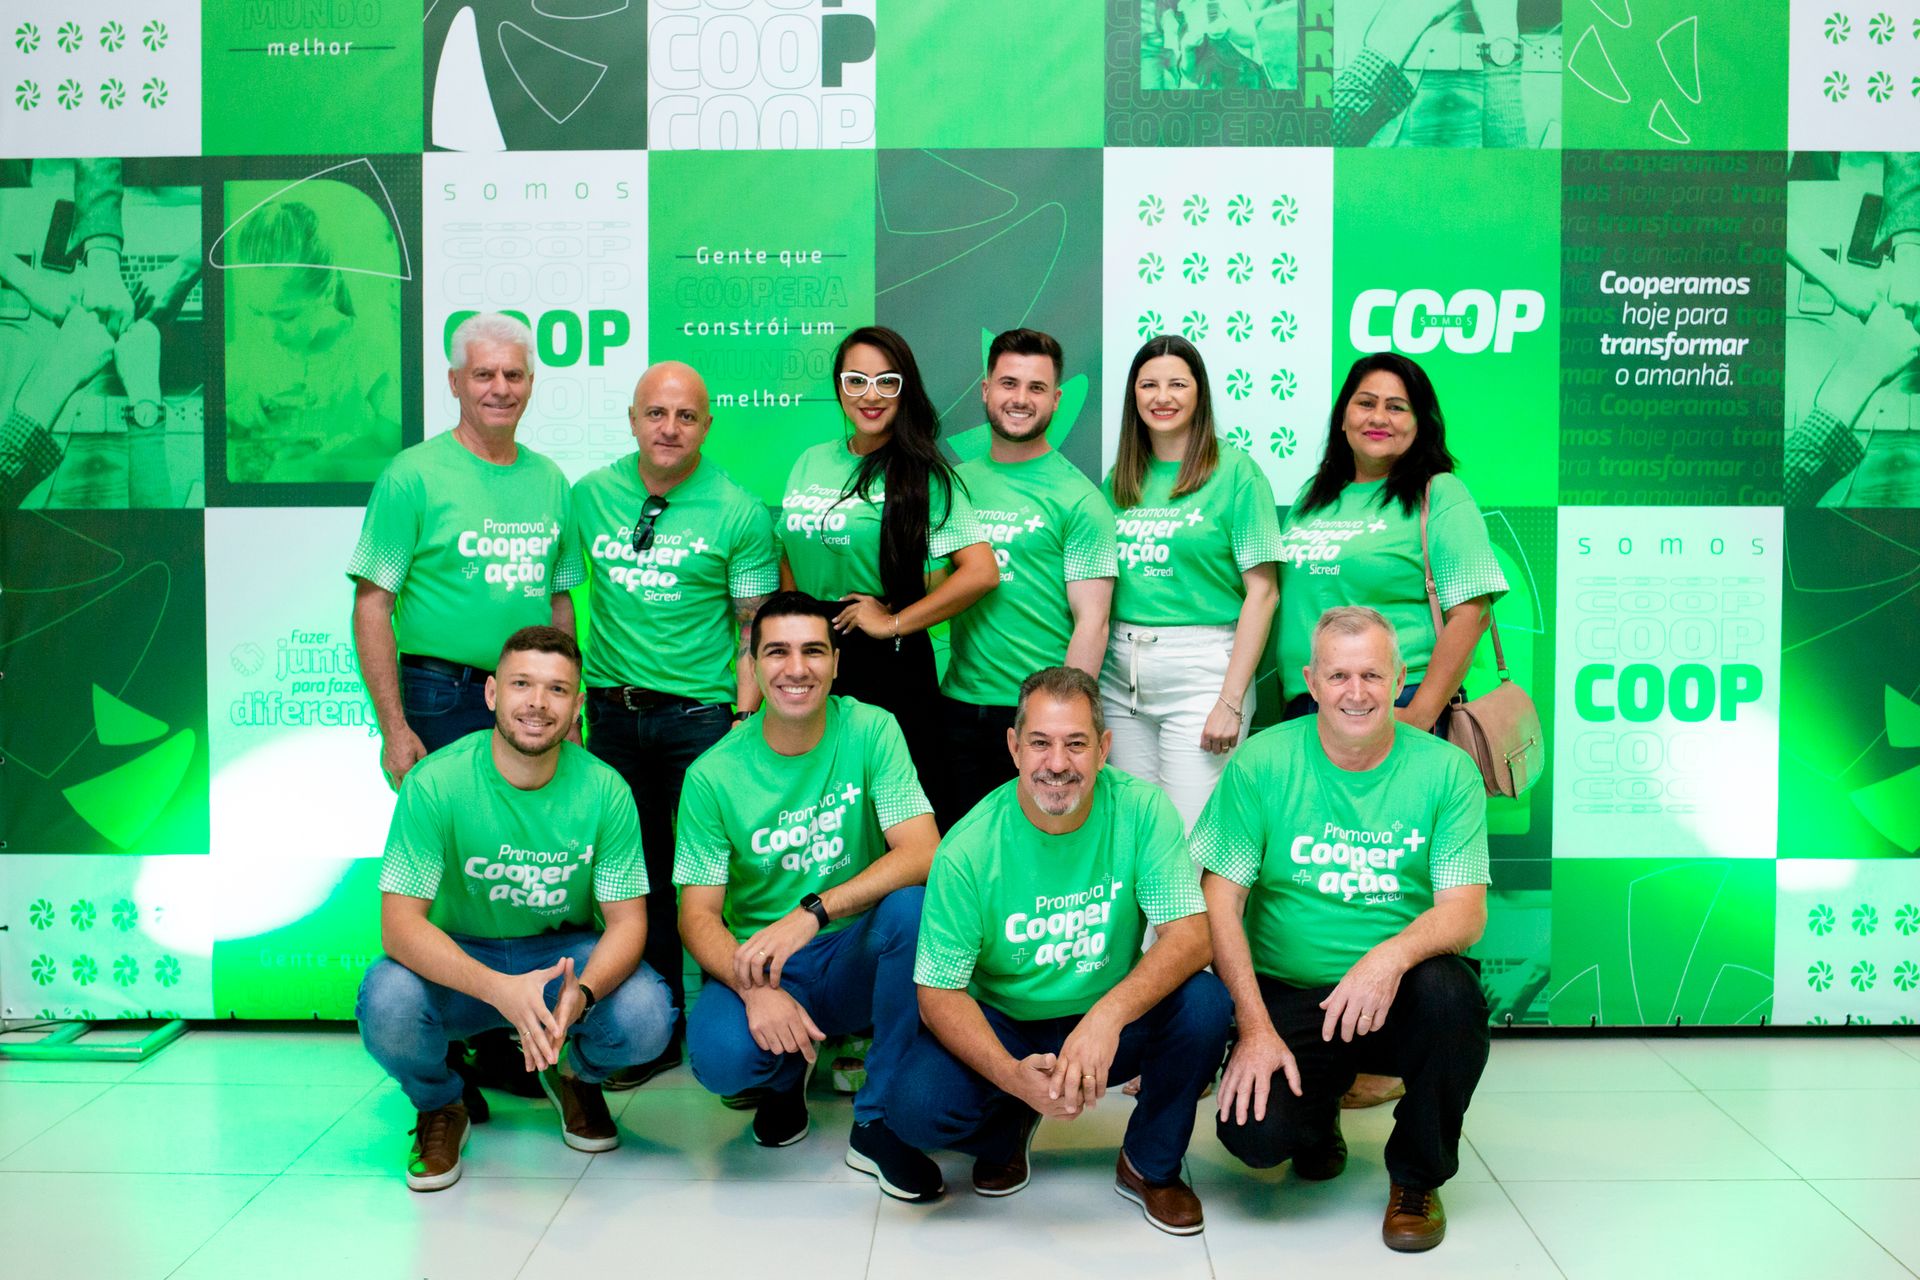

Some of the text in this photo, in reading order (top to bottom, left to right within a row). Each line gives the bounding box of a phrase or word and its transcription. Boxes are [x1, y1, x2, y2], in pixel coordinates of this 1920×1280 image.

[267, 38, 353, 56] melhor
[648, 14, 876, 91] COOP
[648, 94, 876, 150] COOP
[1105, 112, 1334, 147] COOPERAR
[443, 181, 630, 201] somos
[696, 247, 823, 268] Gente que
[442, 262, 631, 305] COOP
[675, 276, 848, 308] COOPERA
[1600, 270, 1750, 299] Cooperamos
[684, 317, 835, 336] constrói um
[1349, 288, 1546, 354] COOP
[1420, 316, 1473, 326] SOMOS
[1622, 301, 1728, 330] hoje para
[1600, 332, 1749, 360] transformar
[1615, 362, 1734, 386] o amanhã.
[716, 389, 804, 407] melhor
[1600, 393, 1750, 420] Cooperamos
[1598, 454, 1746, 482] transformar
[1124, 506, 1180, 518] Promova
[1308, 519, 1363, 529] Promova
[484, 518, 544, 533] Promova
[617, 526, 682, 545] Prova
[1115, 519, 1184, 543] ooper
[458, 530, 552, 562] Cooper
[591, 534, 690, 567] Cooper
[1577, 537, 1765, 556] somos
[484, 556, 545, 592] ação
[609, 563, 679, 592] ação
[1143, 565, 1174, 577] Sicredi
[1309, 564, 1341, 576] Sicredi
[643, 590, 683, 602] Sicredi
[291, 629, 332, 644] Fazer
[1575, 617, 1765, 660] COOP
[292, 680, 325, 696] para
[1574, 663, 1763, 723] COOP
[1323, 822, 1393, 844] Promova
[781, 833, 844, 875] ação
[818, 854, 851, 877] Sicredi
[1290, 835, 1405, 871] Cooper
[464, 856, 579, 890] Cooper
[1317, 867, 1400, 902] ação
[489, 883, 568, 907] ação
[1005, 901, 1112, 944] Cooper
[260, 948, 328, 968] Gente
[1034, 929, 1106, 970] ação
[1075, 953, 1110, 974] Sicredi
